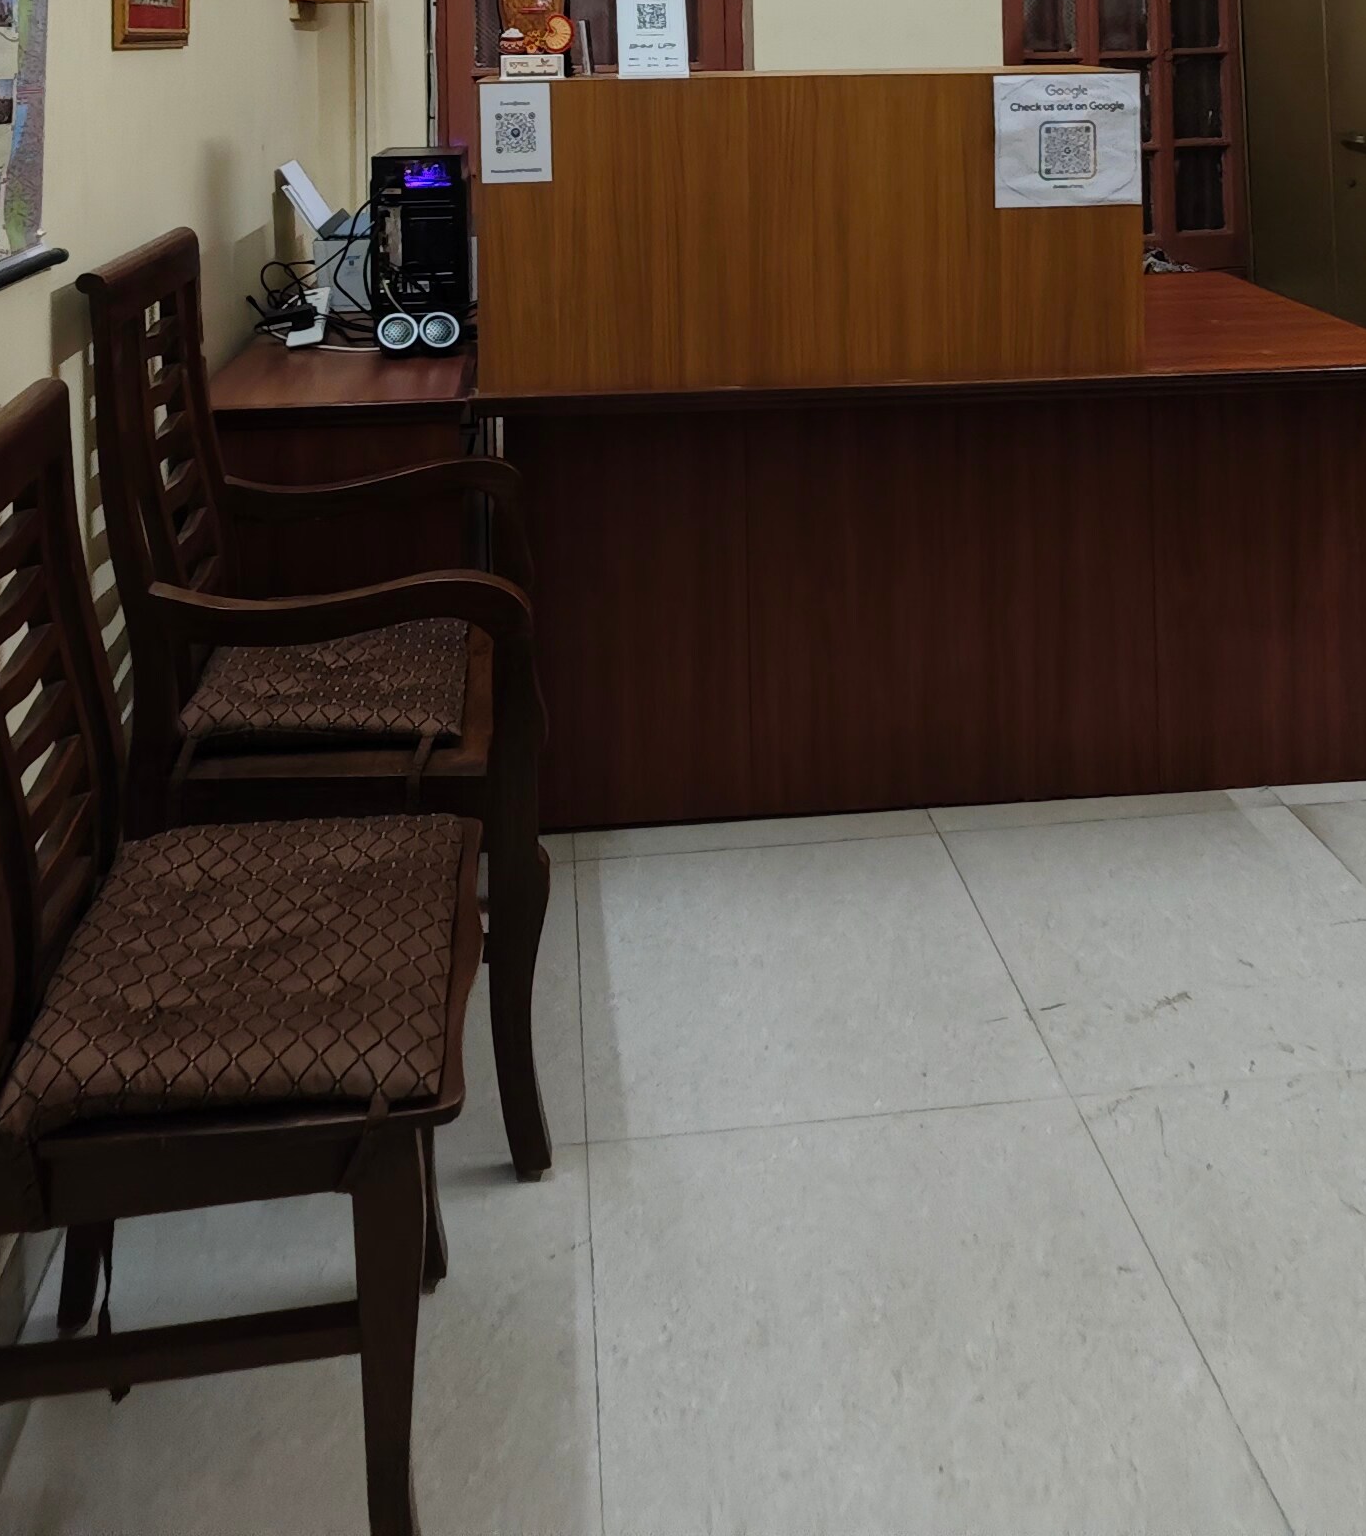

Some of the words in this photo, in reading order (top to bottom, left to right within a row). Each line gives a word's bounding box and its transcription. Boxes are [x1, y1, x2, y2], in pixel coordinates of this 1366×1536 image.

[1044, 83, 1088, 99] Google
[1009, 102, 1041, 112] Check
[1043, 103, 1055, 111] us
[1056, 102, 1074, 111] out
[1074, 103, 1088, 111] on
[1088, 101, 1125, 112] Google
